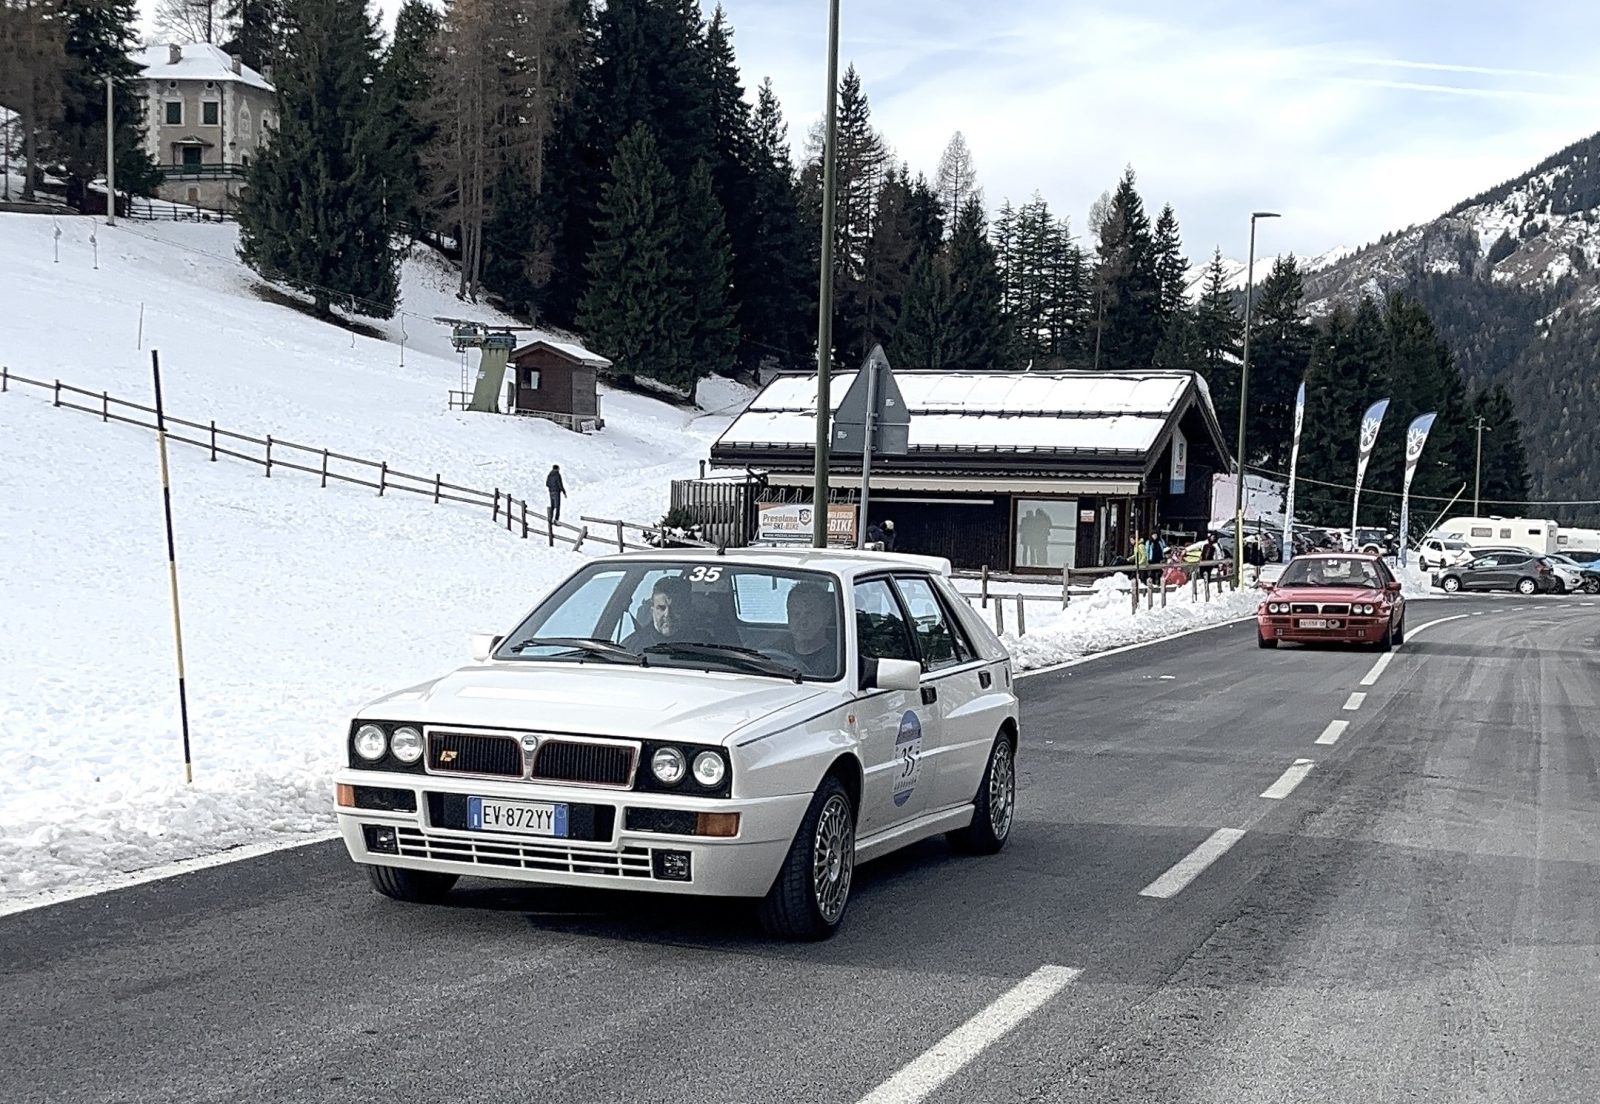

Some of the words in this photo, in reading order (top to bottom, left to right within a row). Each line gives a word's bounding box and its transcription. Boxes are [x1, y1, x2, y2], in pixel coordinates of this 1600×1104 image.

[763, 513, 798, 523] Presolana
[689, 566, 723, 582] 35
[902, 745, 915, 778] 35
